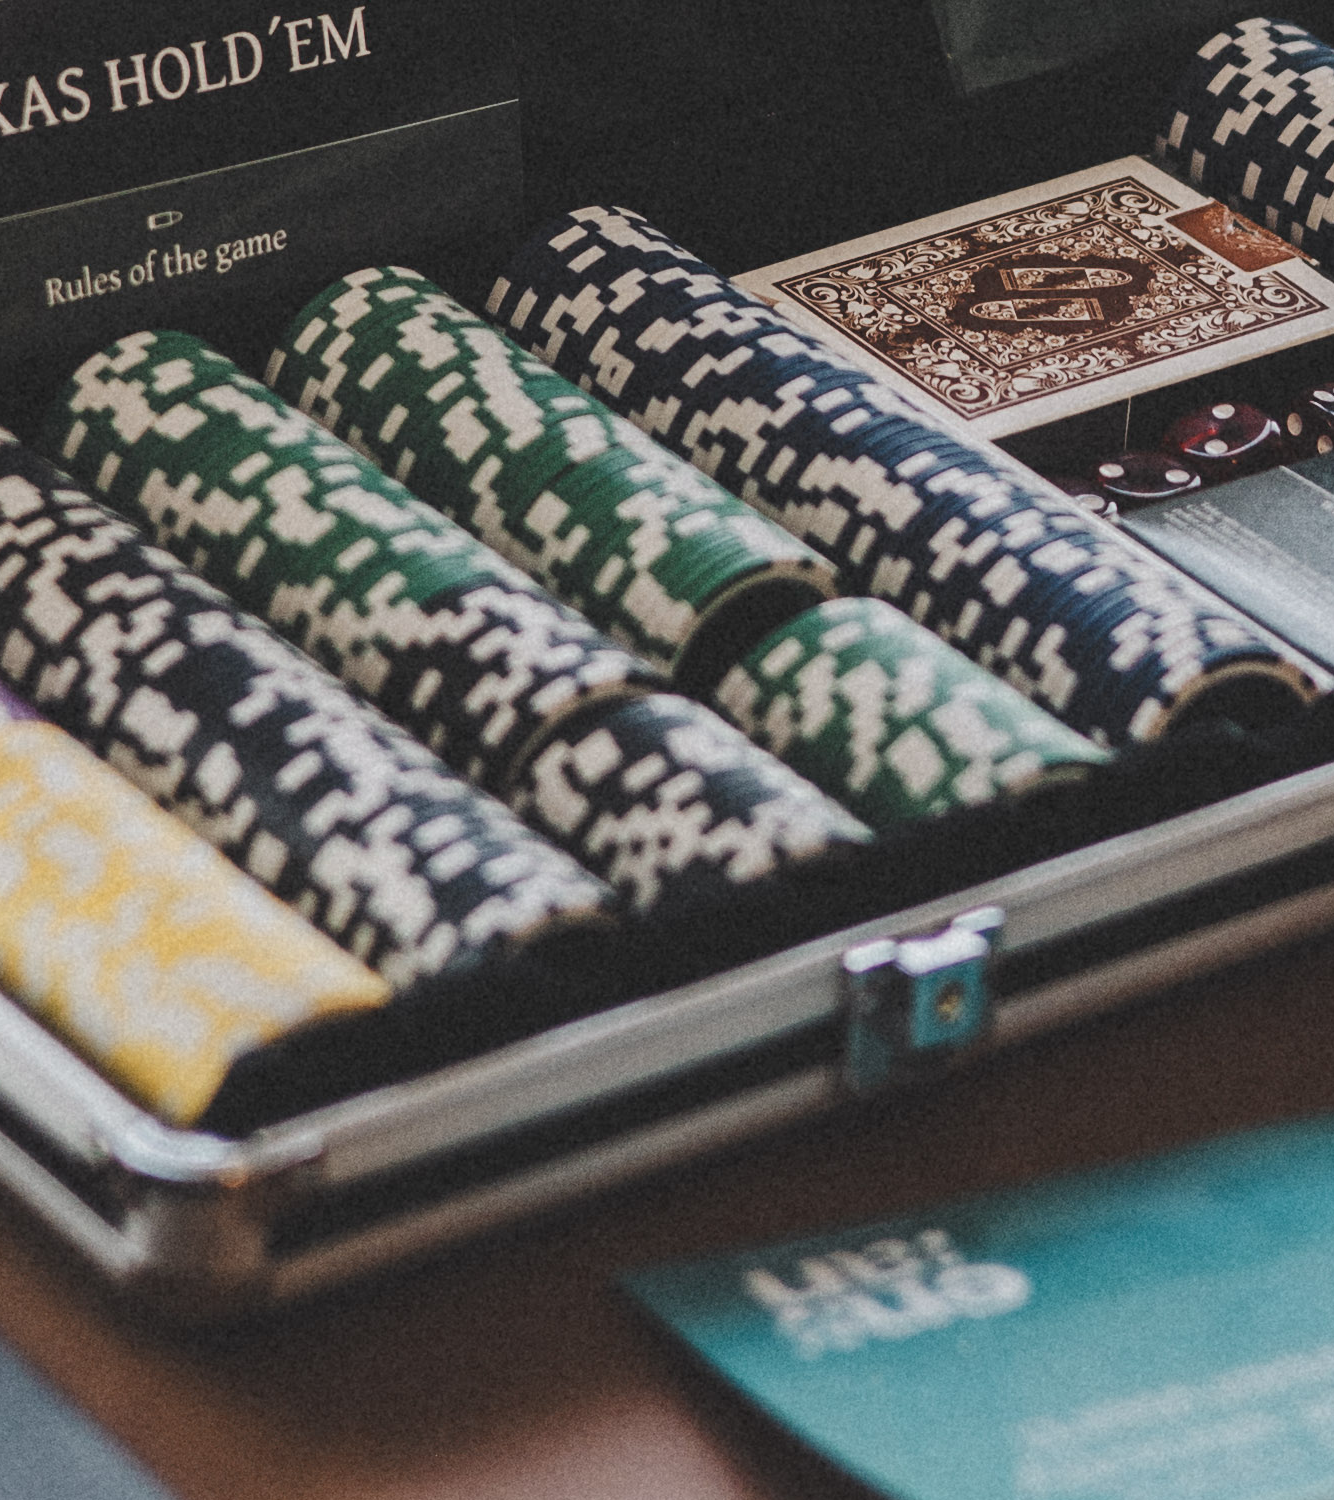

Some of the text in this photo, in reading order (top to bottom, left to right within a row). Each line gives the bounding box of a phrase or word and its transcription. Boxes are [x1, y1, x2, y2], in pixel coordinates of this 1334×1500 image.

[45, 229, 288, 307] Rules of the game
